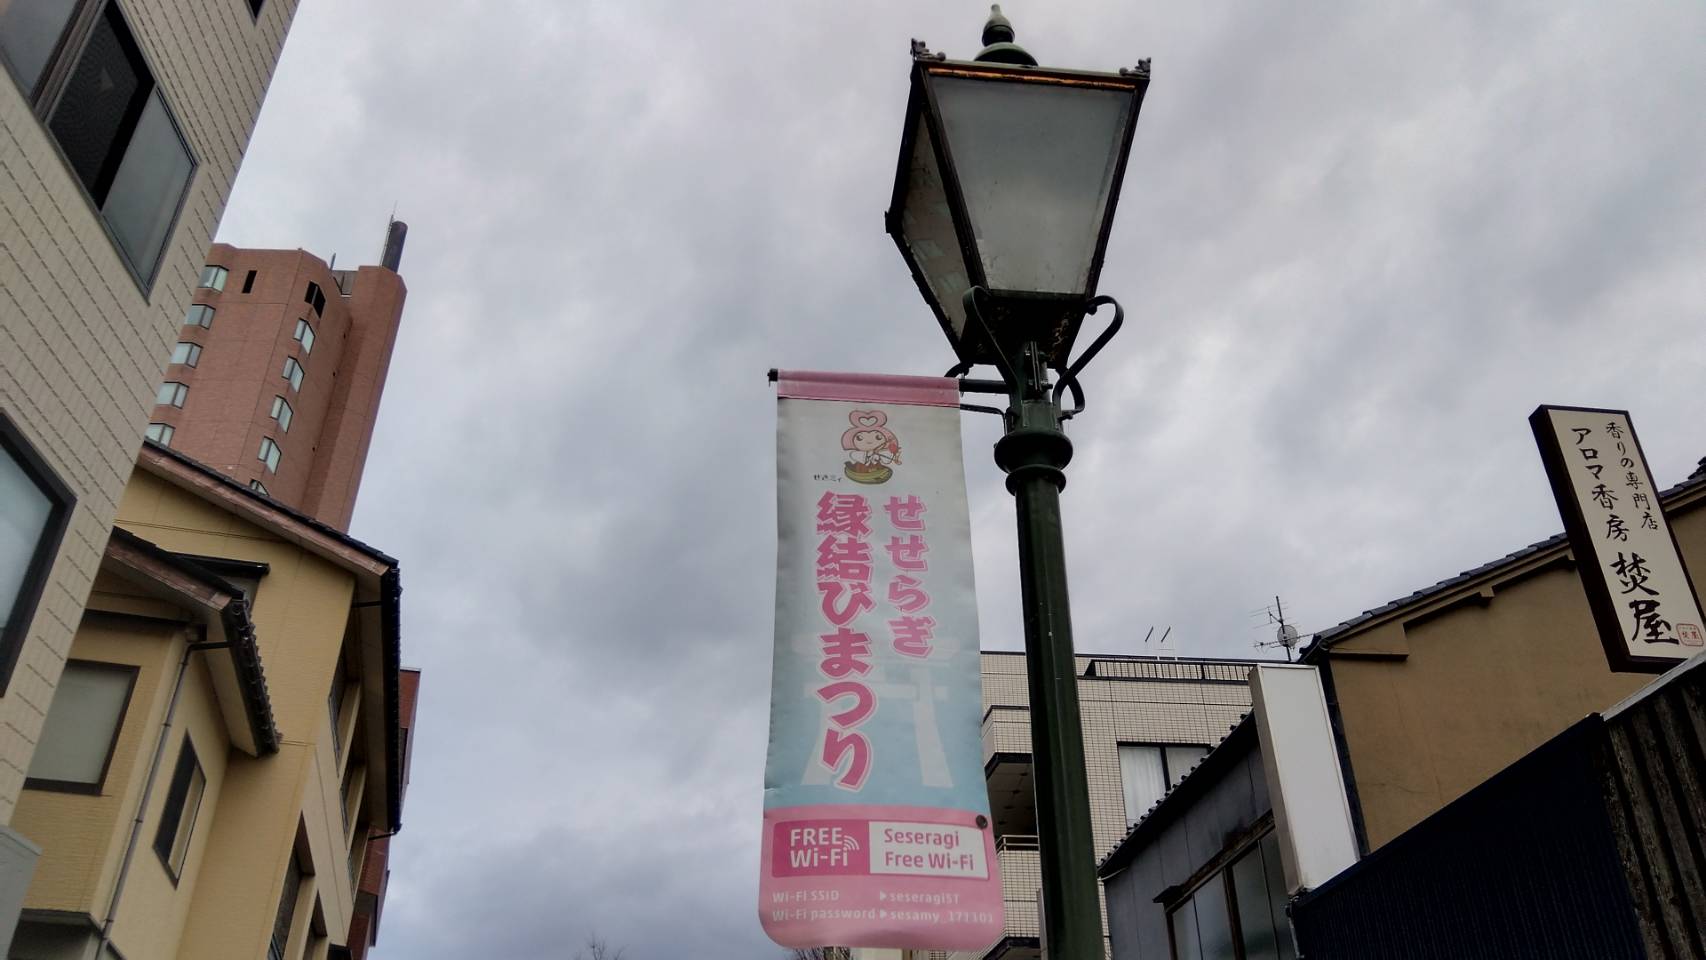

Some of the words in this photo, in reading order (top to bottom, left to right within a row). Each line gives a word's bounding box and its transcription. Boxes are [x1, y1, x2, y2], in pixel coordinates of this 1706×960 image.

[1571, 427, 1630, 542] アロマ香房
[1605, 422, 1659, 531] 香りの専門店
[884, 494, 936, 659] せせらぎ
[816, 490, 877, 792] 縁結びまつり
[790, 827, 843, 847] FREE
[884, 828, 960, 849] Seseragi
[790, 849, 848, 869] Wi-Fi
[885, 851, 924, 868] Free
[928, 854, 974, 870] Wi-Fi
[772, 891, 807, 903] Wi-Fi
[811, 889, 840, 901] SSID
[772, 909, 807, 922] Wi-Fi
[811, 908, 876, 921] password
